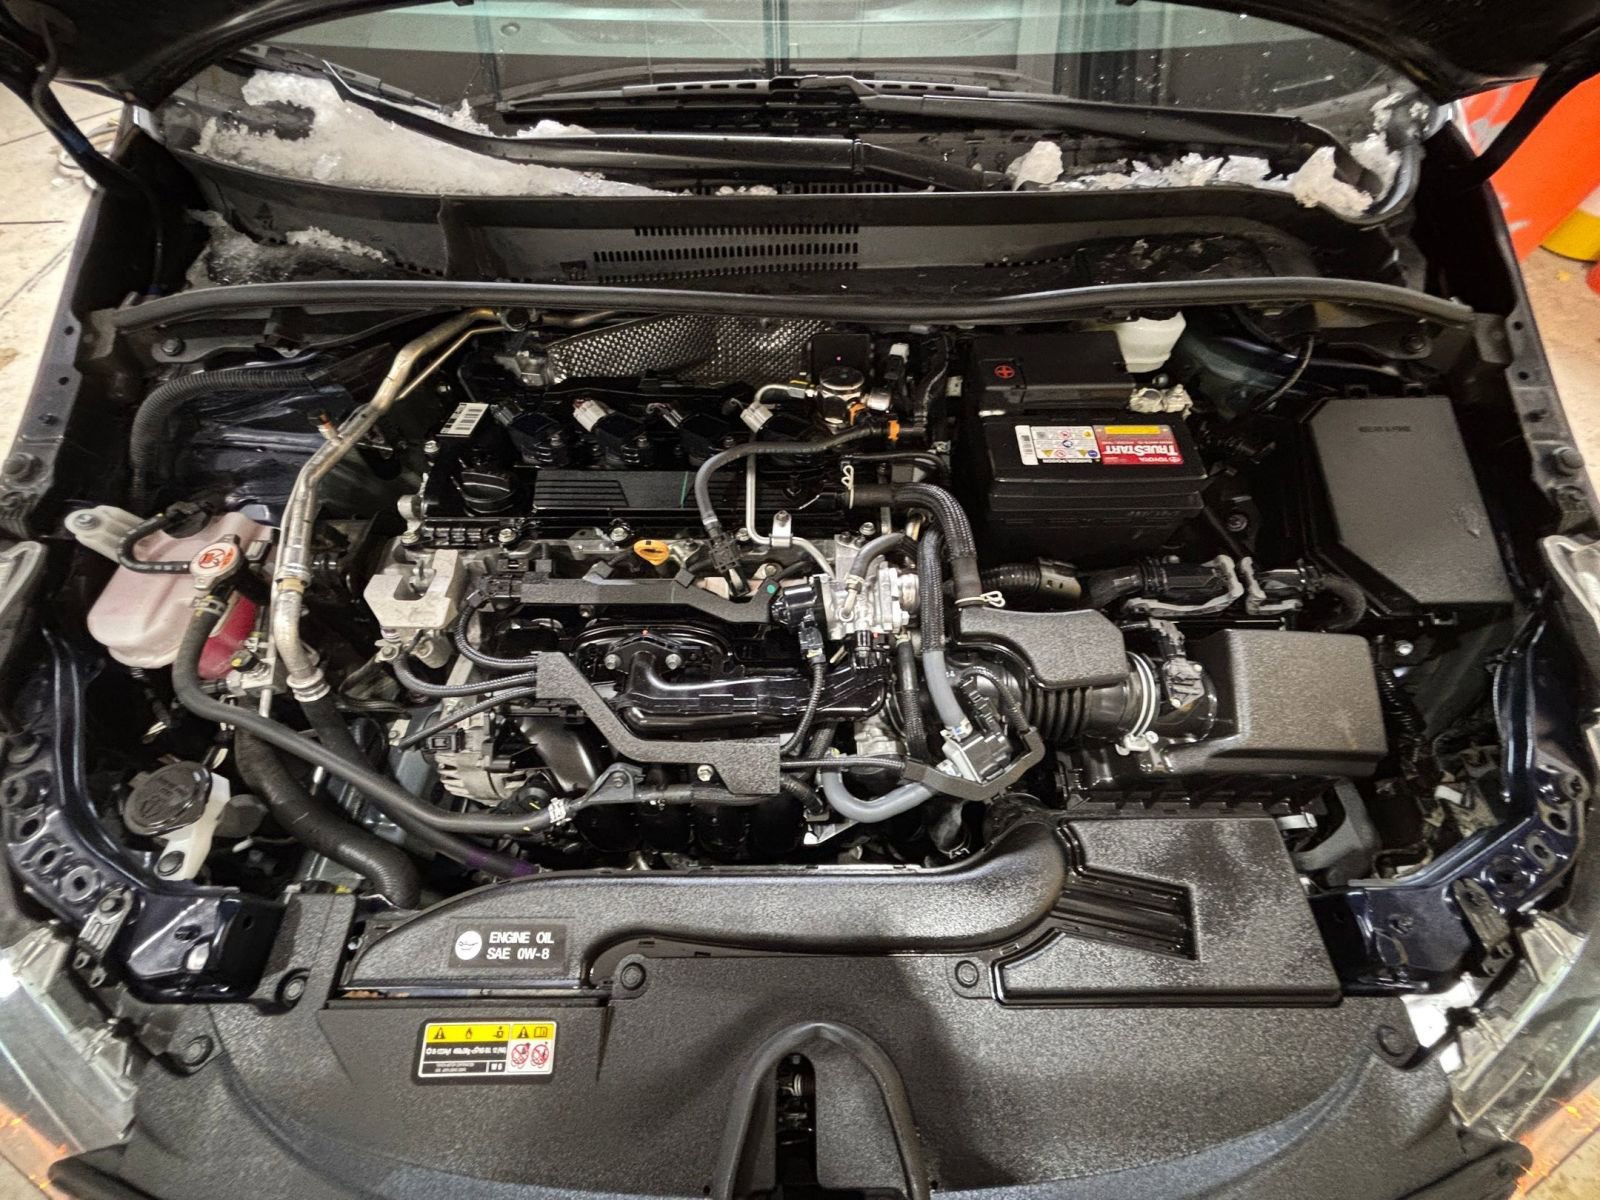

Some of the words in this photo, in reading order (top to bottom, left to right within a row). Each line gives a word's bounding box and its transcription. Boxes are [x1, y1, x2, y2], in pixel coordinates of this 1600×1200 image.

[488, 931, 531, 944] ENGINE
[535, 931, 555, 944] OIL
[486, 947, 512, 960] SAE
[516, 947, 550, 960] 0W-8
